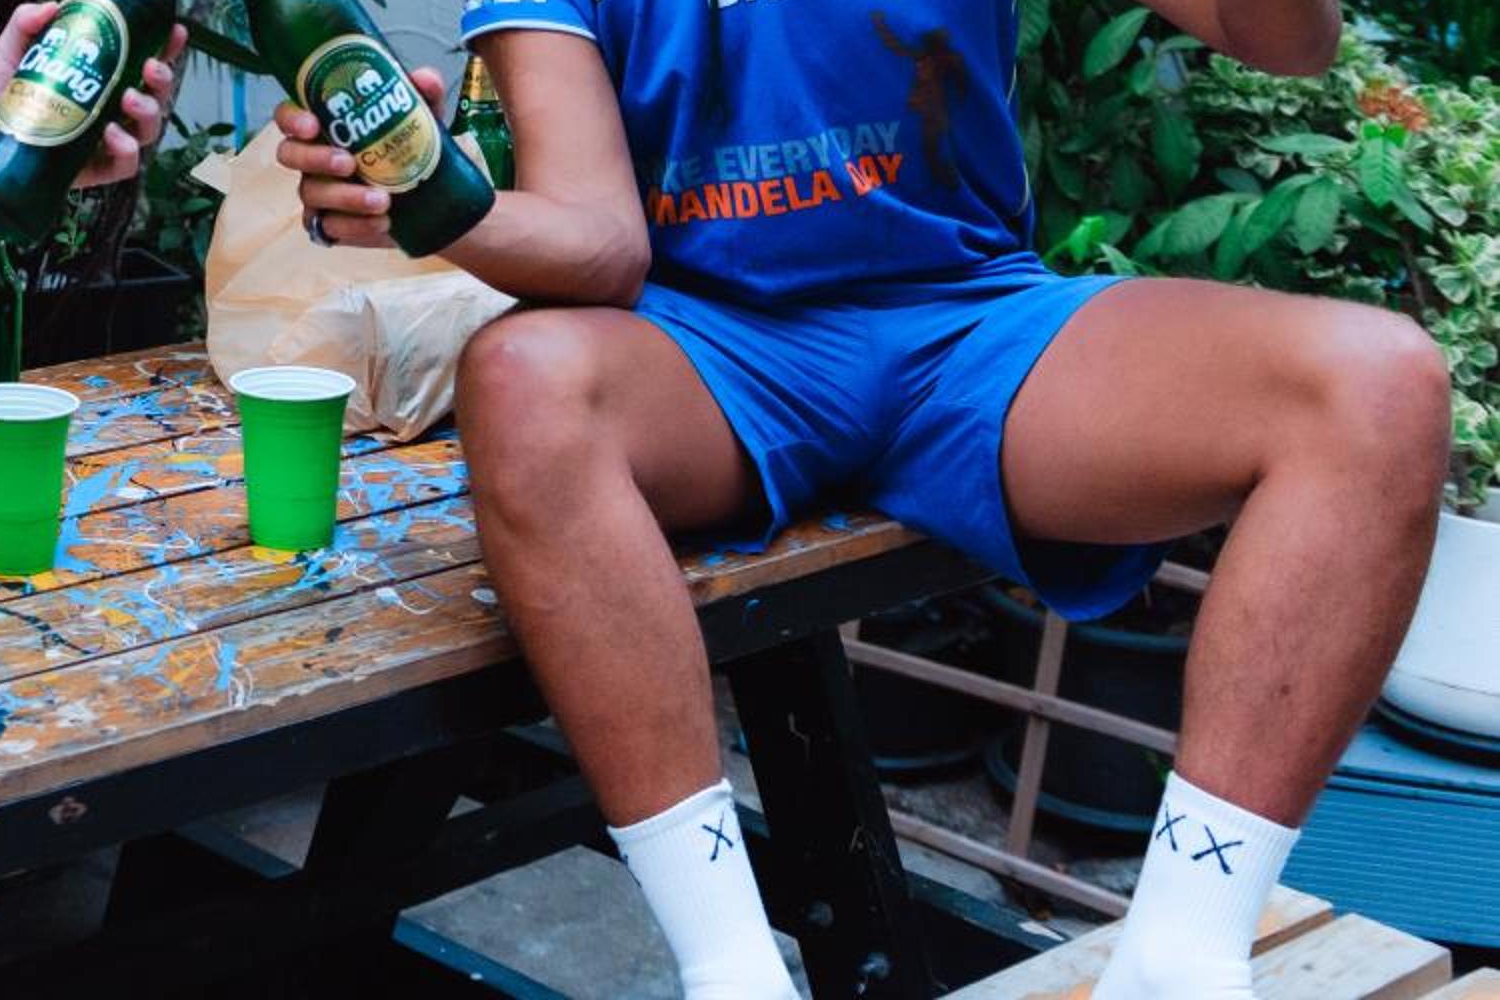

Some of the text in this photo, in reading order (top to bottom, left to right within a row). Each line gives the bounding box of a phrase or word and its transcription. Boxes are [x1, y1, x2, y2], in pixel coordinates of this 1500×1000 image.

[18, 43, 101, 103] Chang
[329, 80, 413, 147] Chang
[714, 121, 900, 181] EVERYDAY
[647, 171, 842, 226] MANDELA
